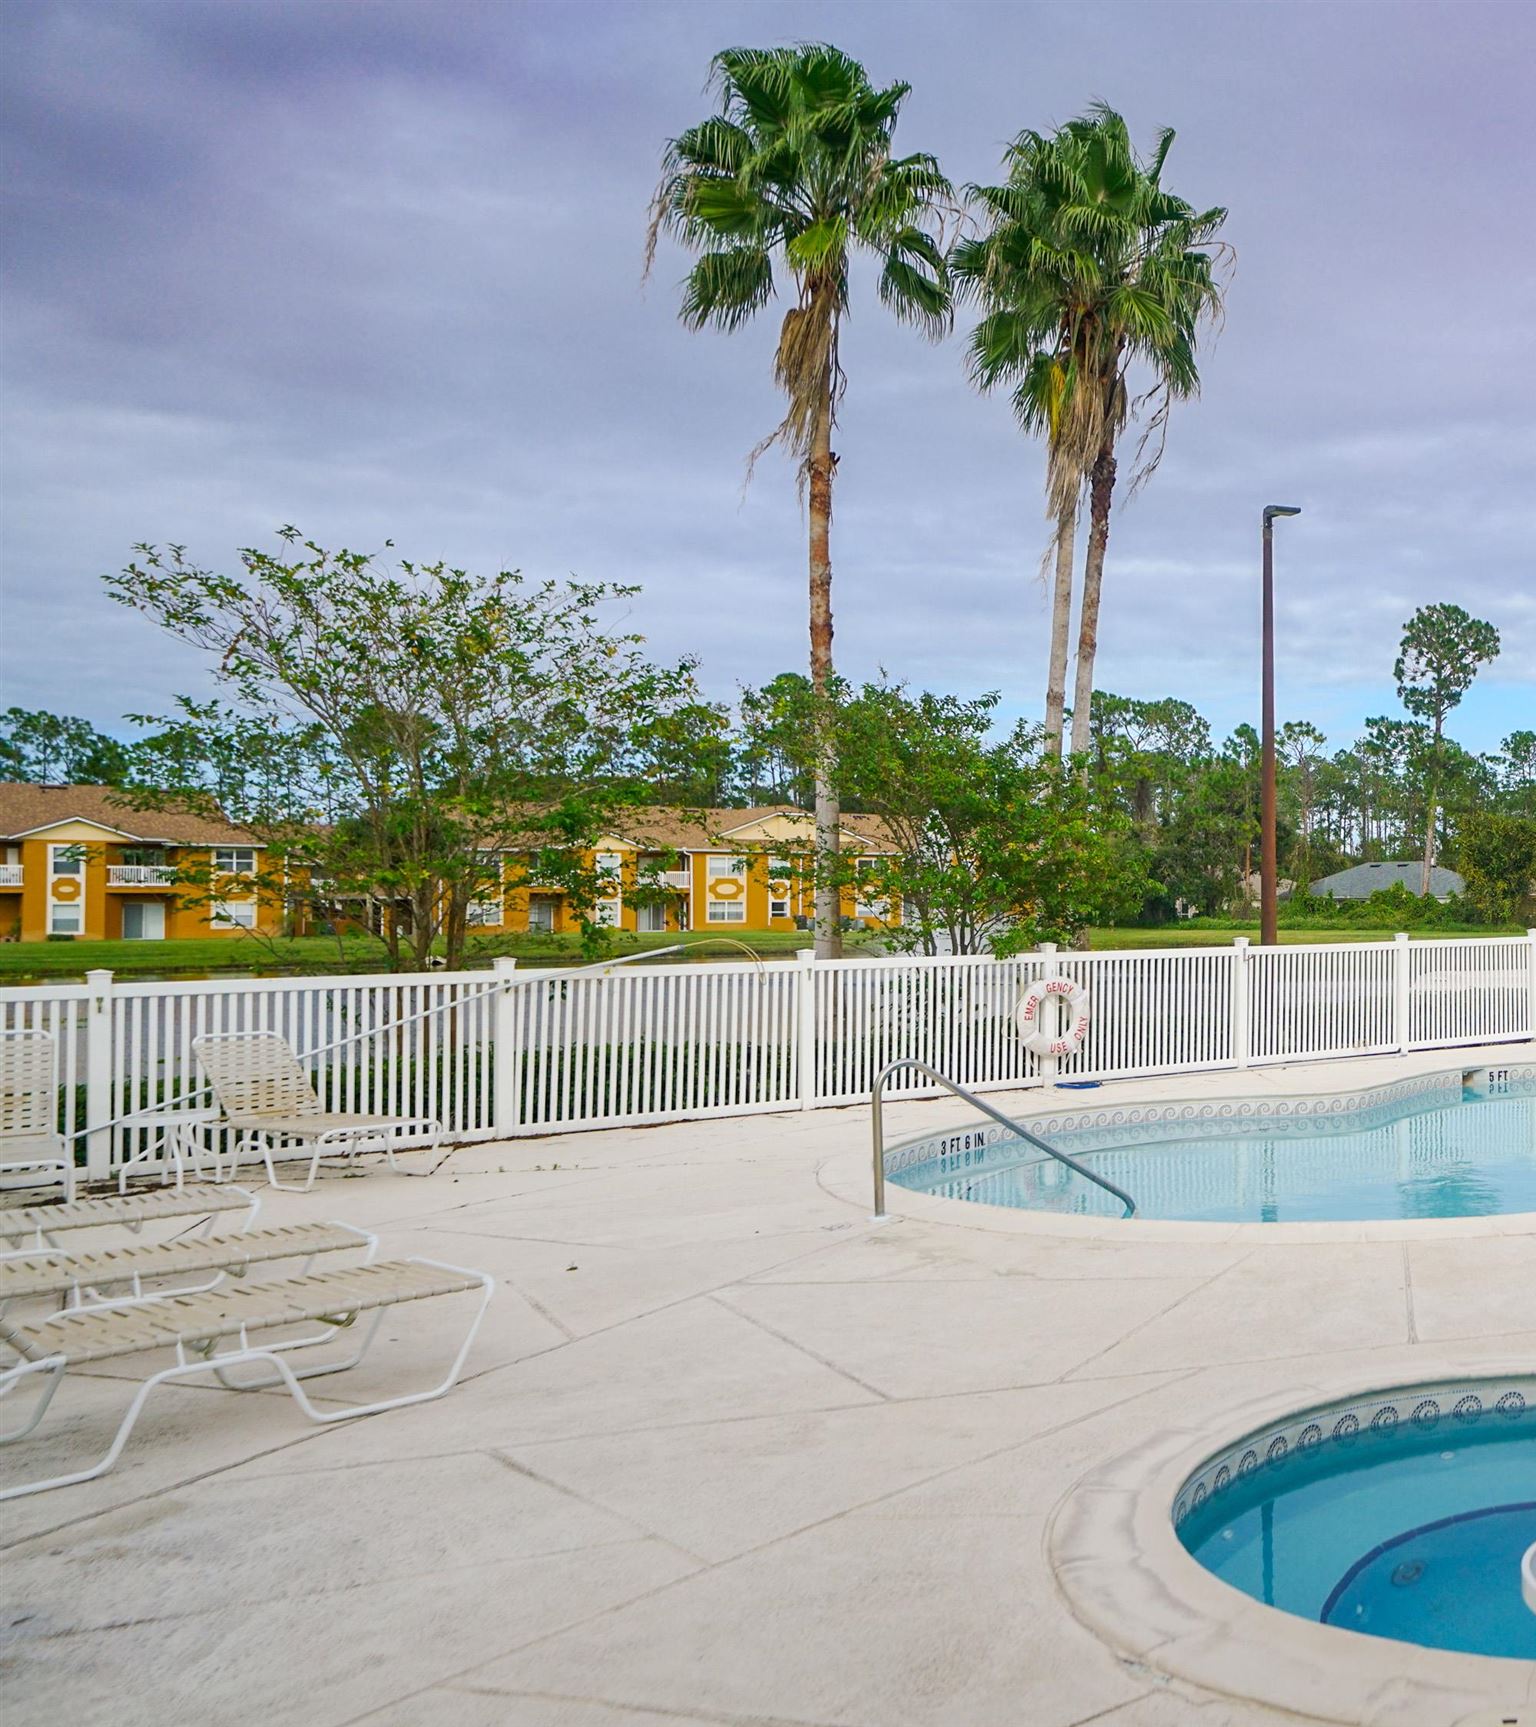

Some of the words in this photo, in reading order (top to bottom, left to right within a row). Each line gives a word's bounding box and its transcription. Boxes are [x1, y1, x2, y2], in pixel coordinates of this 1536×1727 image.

[1050, 1042, 1068, 1054] USE
[1073, 1016, 1088, 1041] ONLY
[1489, 1072, 1494, 1082] 5
[941, 1140, 946, 1156] 3
[965, 1135, 970, 1150] 6
